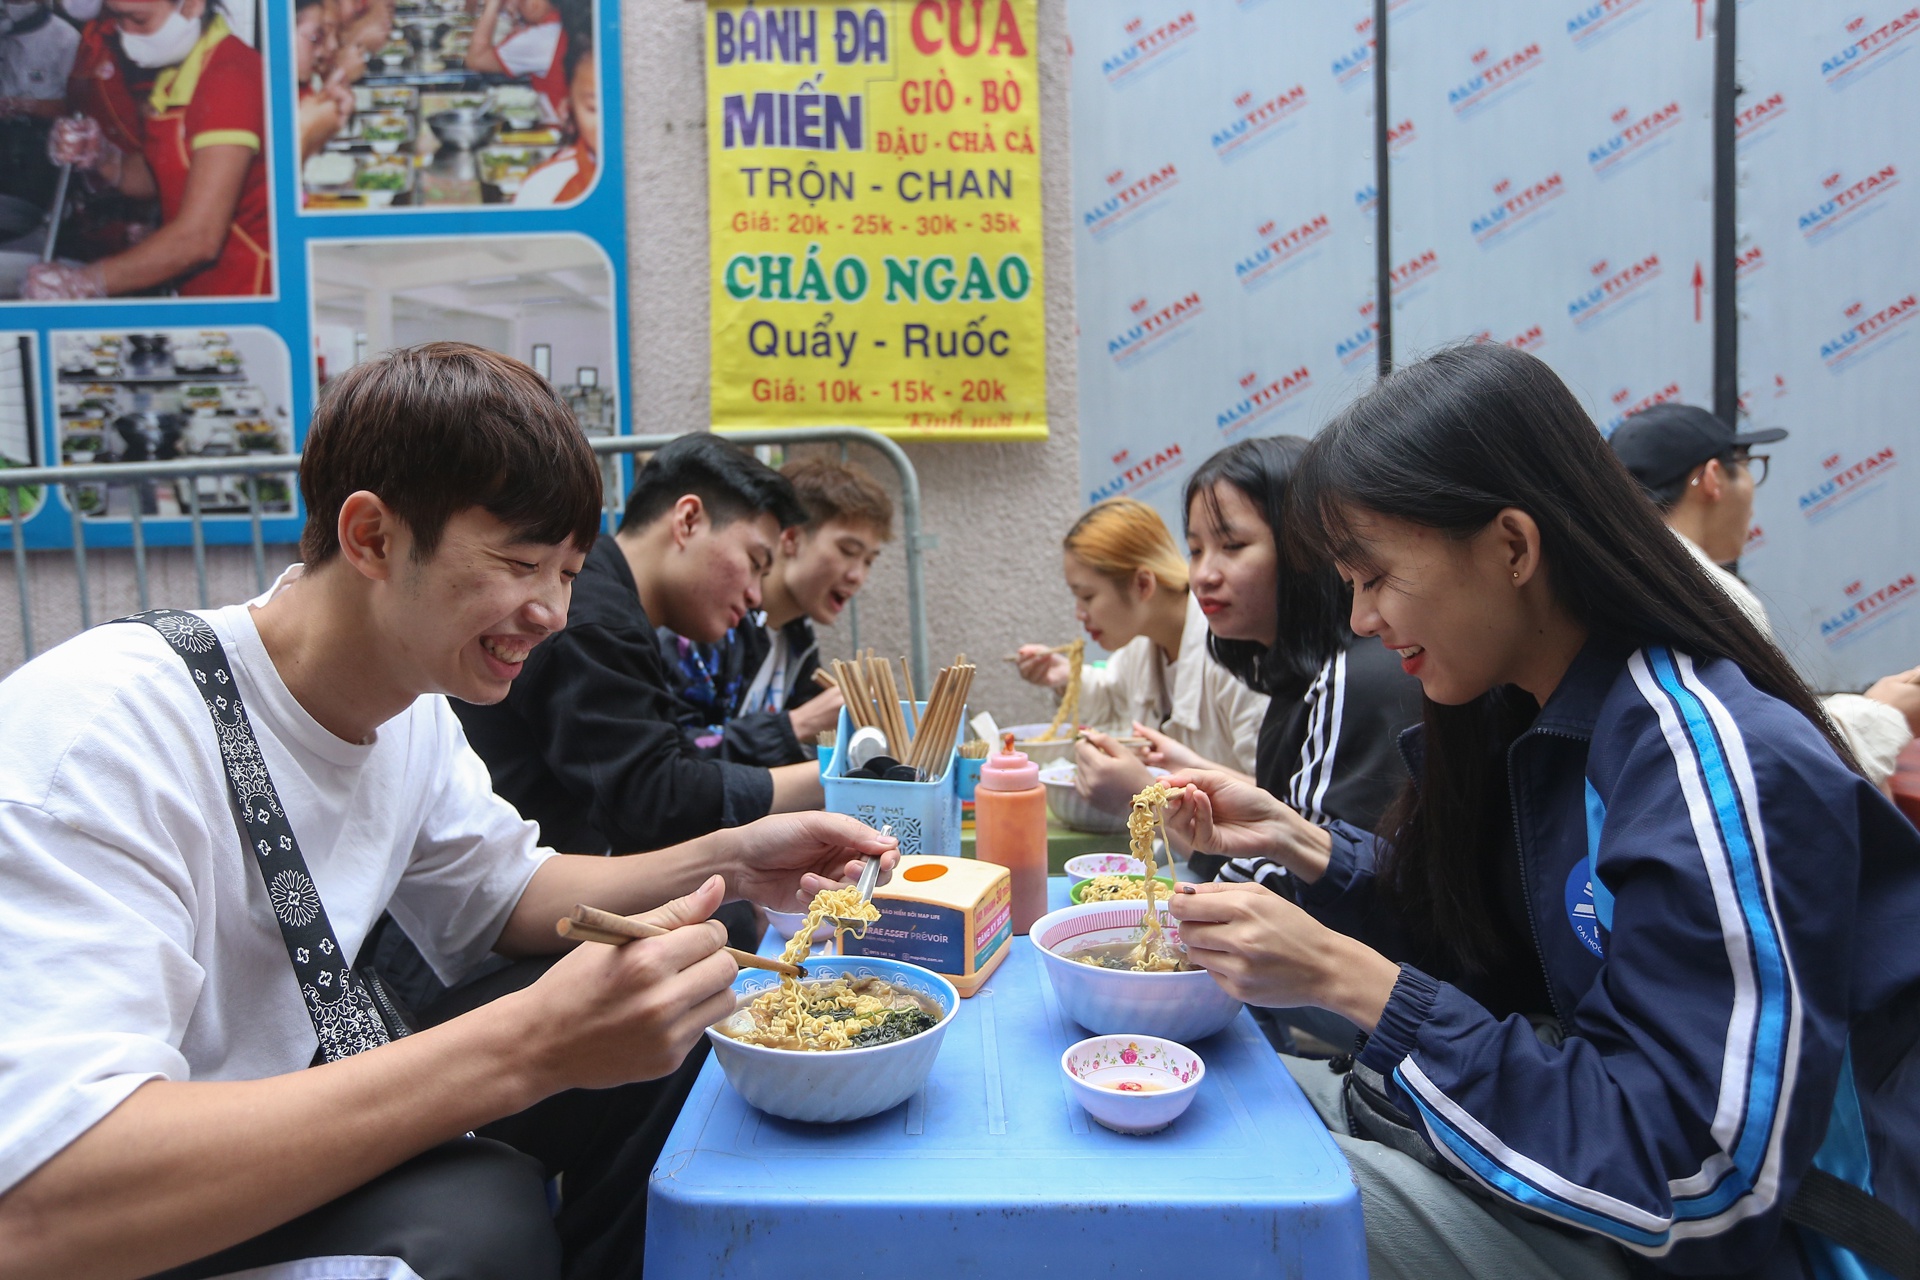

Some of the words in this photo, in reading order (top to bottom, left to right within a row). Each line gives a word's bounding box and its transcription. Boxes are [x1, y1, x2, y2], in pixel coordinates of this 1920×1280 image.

[833, 8, 888, 65] ĐA
[911, 0, 1028, 58] CUA
[1102, 11, 1196, 75] ALUTITAN
[1820, 8, 1920, 74] ALUTITAN
[900, 68, 955, 115] GIÒ
[981, 70, 1021, 114] BÒ
[1448, 42, 1541, 104] ALUTITAN
[722, 73, 863, 151] MIẾN
[876, 126, 928, 161] ĐẬU
[1004, 124, 1035, 154] CÁ
[1211, 84, 1305, 147] ALUTITAN
[1588, 101, 1680, 165] ALUTITAN
[740, 161, 854, 207] TRỘN
[898, 169, 1012, 202] CHAN
[1084, 163, 1177, 226] ALUTITAN
[1470, 172, 1563, 234] ALUTITAN
[1798, 165, 1897, 230] ALUTITAN
[732, 211, 779, 233] Giá:
[788, 214, 829, 235] 20k
[853, 214, 893, 235] 25k
[916, 214, 957, 236] 30k
[981, 213, 1021, 234] 35k
[1235, 214, 1329, 277] ALUTITAN
[724, 243, 868, 303] CHÁO
[883, 255, 1031, 303] NGAO
[1568, 252, 1659, 317] ALUTITAN
[748, 312, 857, 368] Quẩy
[904, 315, 1010, 358] Ruốc
[1107, 293, 1201, 354] ALUTITAN
[1820, 295, 1917, 358] ALUTITAN
[752, 378, 805, 403] Giá:
[817, 380, 862, 403] 10k
[891, 380, 934, 402] 15k
[961, 379, 1007, 402] 20k
[1216, 366, 1310, 428] ALUTITAN
[1090, 443, 1182, 504] ALUTITAN
[1798, 447, 1896, 509] ALUTITAN
[1820, 573, 1916, 636] ALUTITAN
[884, 929, 909, 939] ASSET
